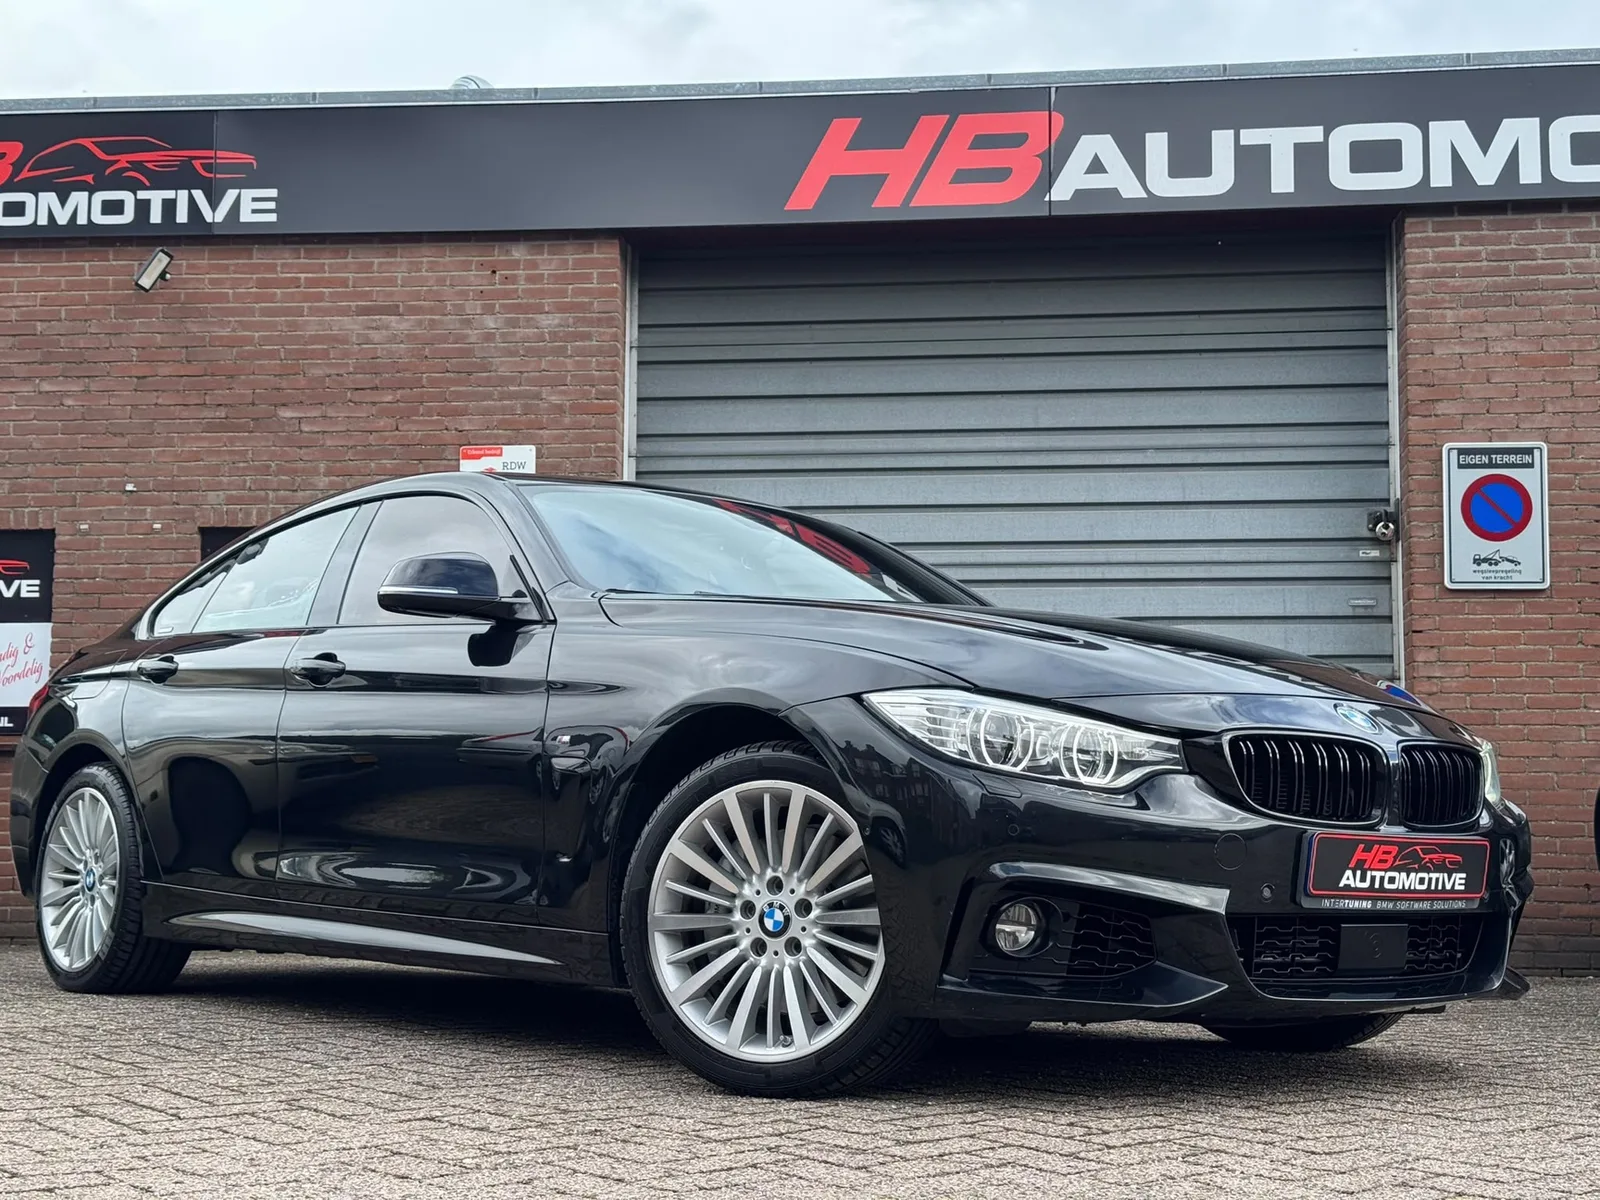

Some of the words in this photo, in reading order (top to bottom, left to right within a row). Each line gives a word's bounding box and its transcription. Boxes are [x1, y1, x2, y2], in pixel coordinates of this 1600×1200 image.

[784, 112, 1064, 211] HB
[0, 188, 278, 226] OMOTIVE
[502, 461, 526, 471] RDW
[1459, 454, 1489, 464] EIGEN
[1491, 454, 1532, 464] TERREIN
[1349, 844, 1399, 870] HB
[1338, 869, 1467, 890] AUTOMOTIVE
[1321, 899, 1372, 909] INTERTUNING
[1376, 901, 1394, 909] BMW
[1396, 901, 1431, 909] SOFTWARE
[1433, 900, 1466, 909] SOLUTIONS
